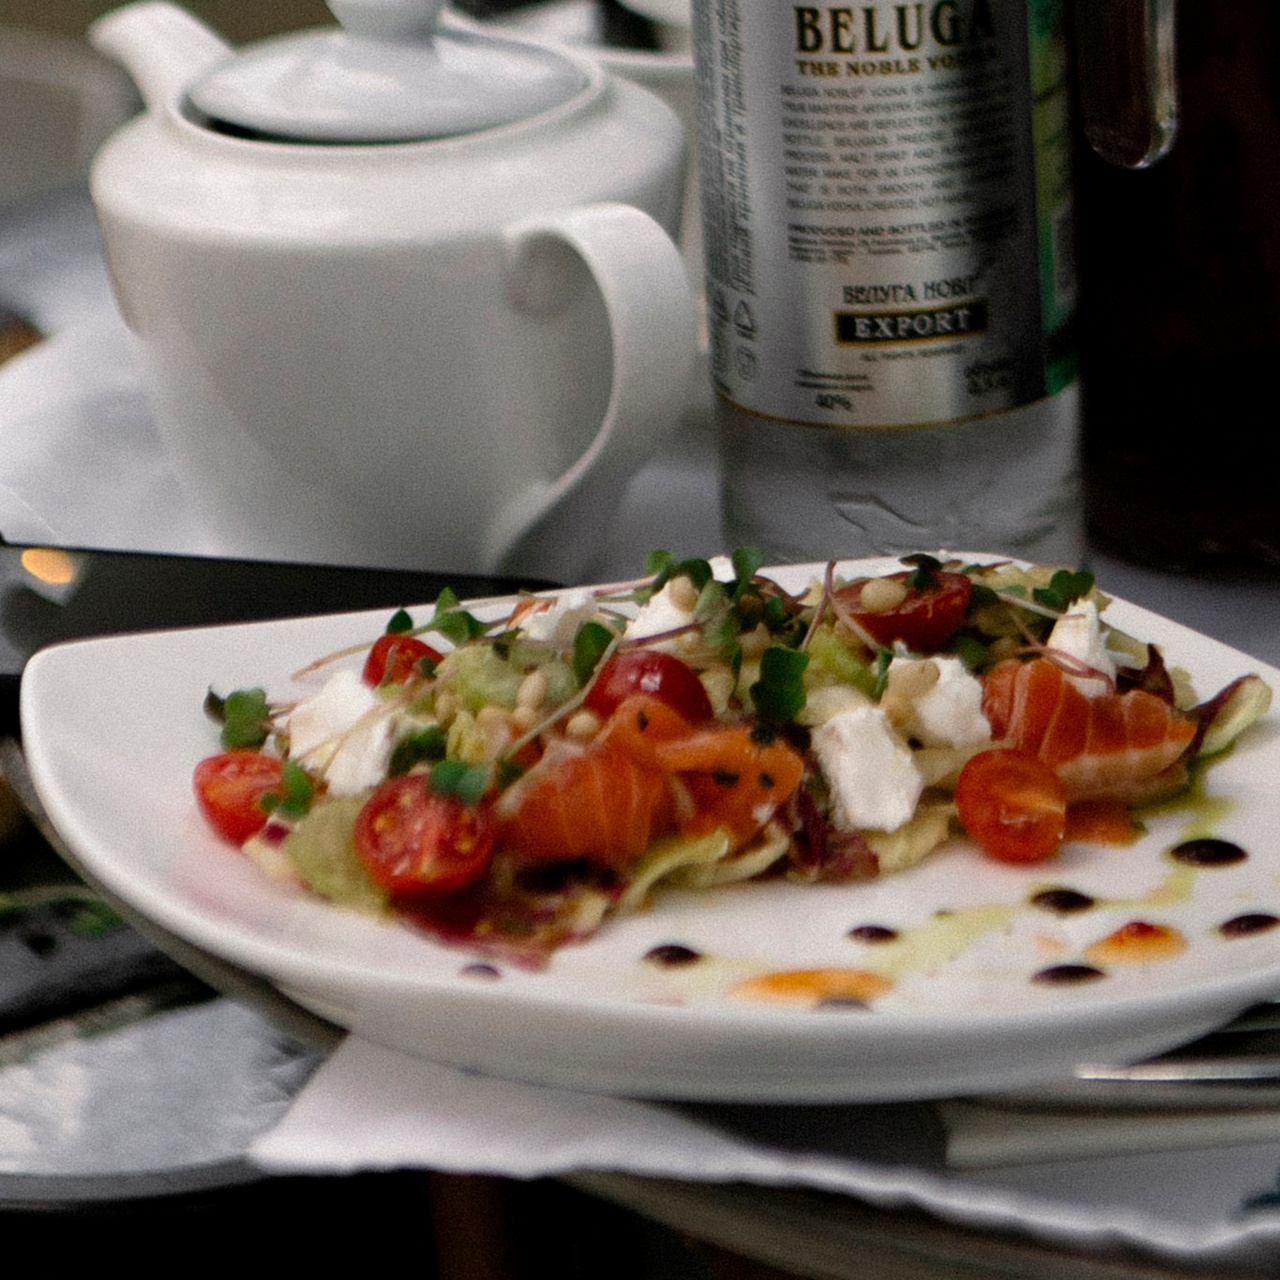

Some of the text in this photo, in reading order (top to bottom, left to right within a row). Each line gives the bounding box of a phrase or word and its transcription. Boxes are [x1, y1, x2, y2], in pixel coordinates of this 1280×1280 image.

[795, 59, 840, 77] THE
[846, 57, 920, 77] NOBLE
[854, 307, 974, 339] EXPORT
